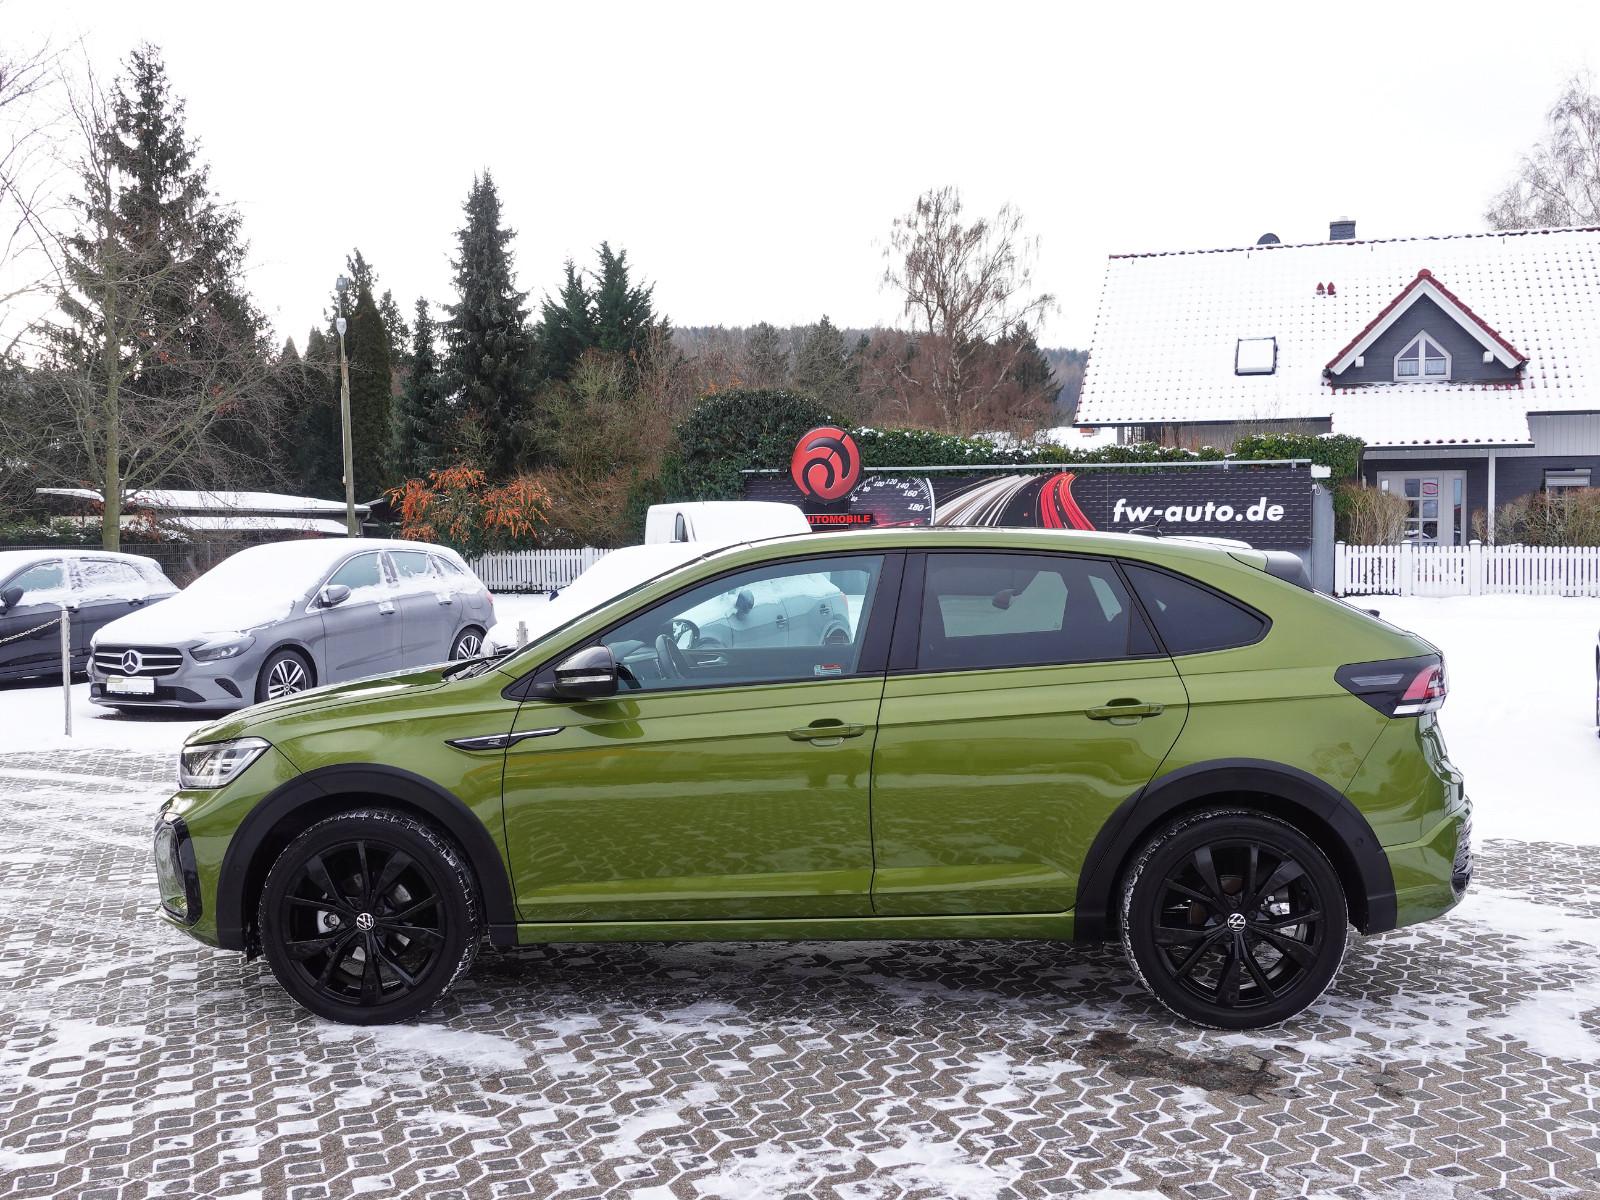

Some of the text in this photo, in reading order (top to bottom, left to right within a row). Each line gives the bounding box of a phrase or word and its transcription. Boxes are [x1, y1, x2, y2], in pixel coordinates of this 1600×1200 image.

[903, 489, 918, 497] 160
[908, 503, 924, 511] 180
[1113, 496, 1284, 522] fw-auto.de
[806, 515, 871, 524] UTOMOBILE
